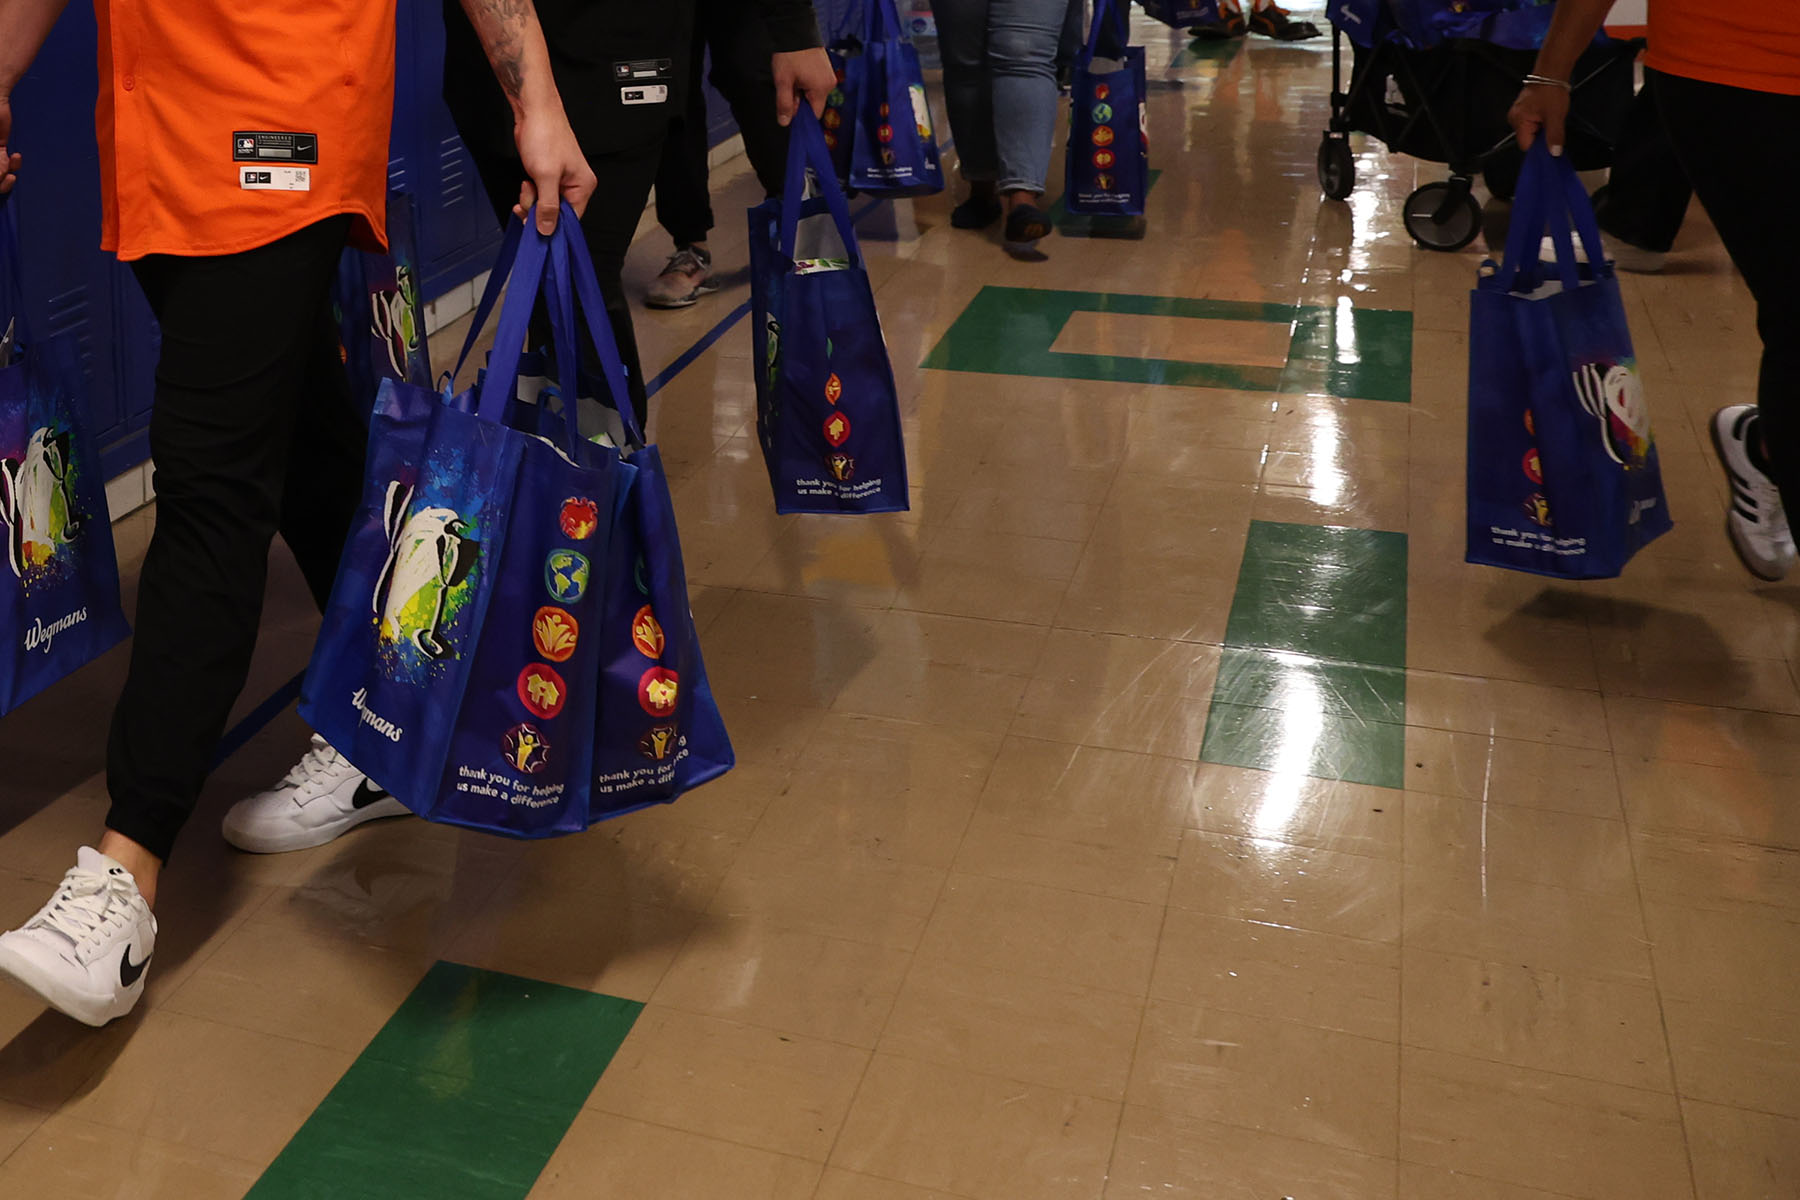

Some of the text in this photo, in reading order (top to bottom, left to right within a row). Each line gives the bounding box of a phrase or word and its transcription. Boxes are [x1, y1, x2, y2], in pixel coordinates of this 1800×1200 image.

[796, 478, 820, 486] thank
[809, 487, 832, 495] make
[840, 486, 881, 499] difference
[24, 606, 87, 654] Wegmans
[459, 765, 565, 797] thank you for helping
[599, 763, 672, 783] thank you for
[600, 785, 613, 793] us
[616, 777, 645, 791] make
[456, 782, 560, 809] us make a difference
